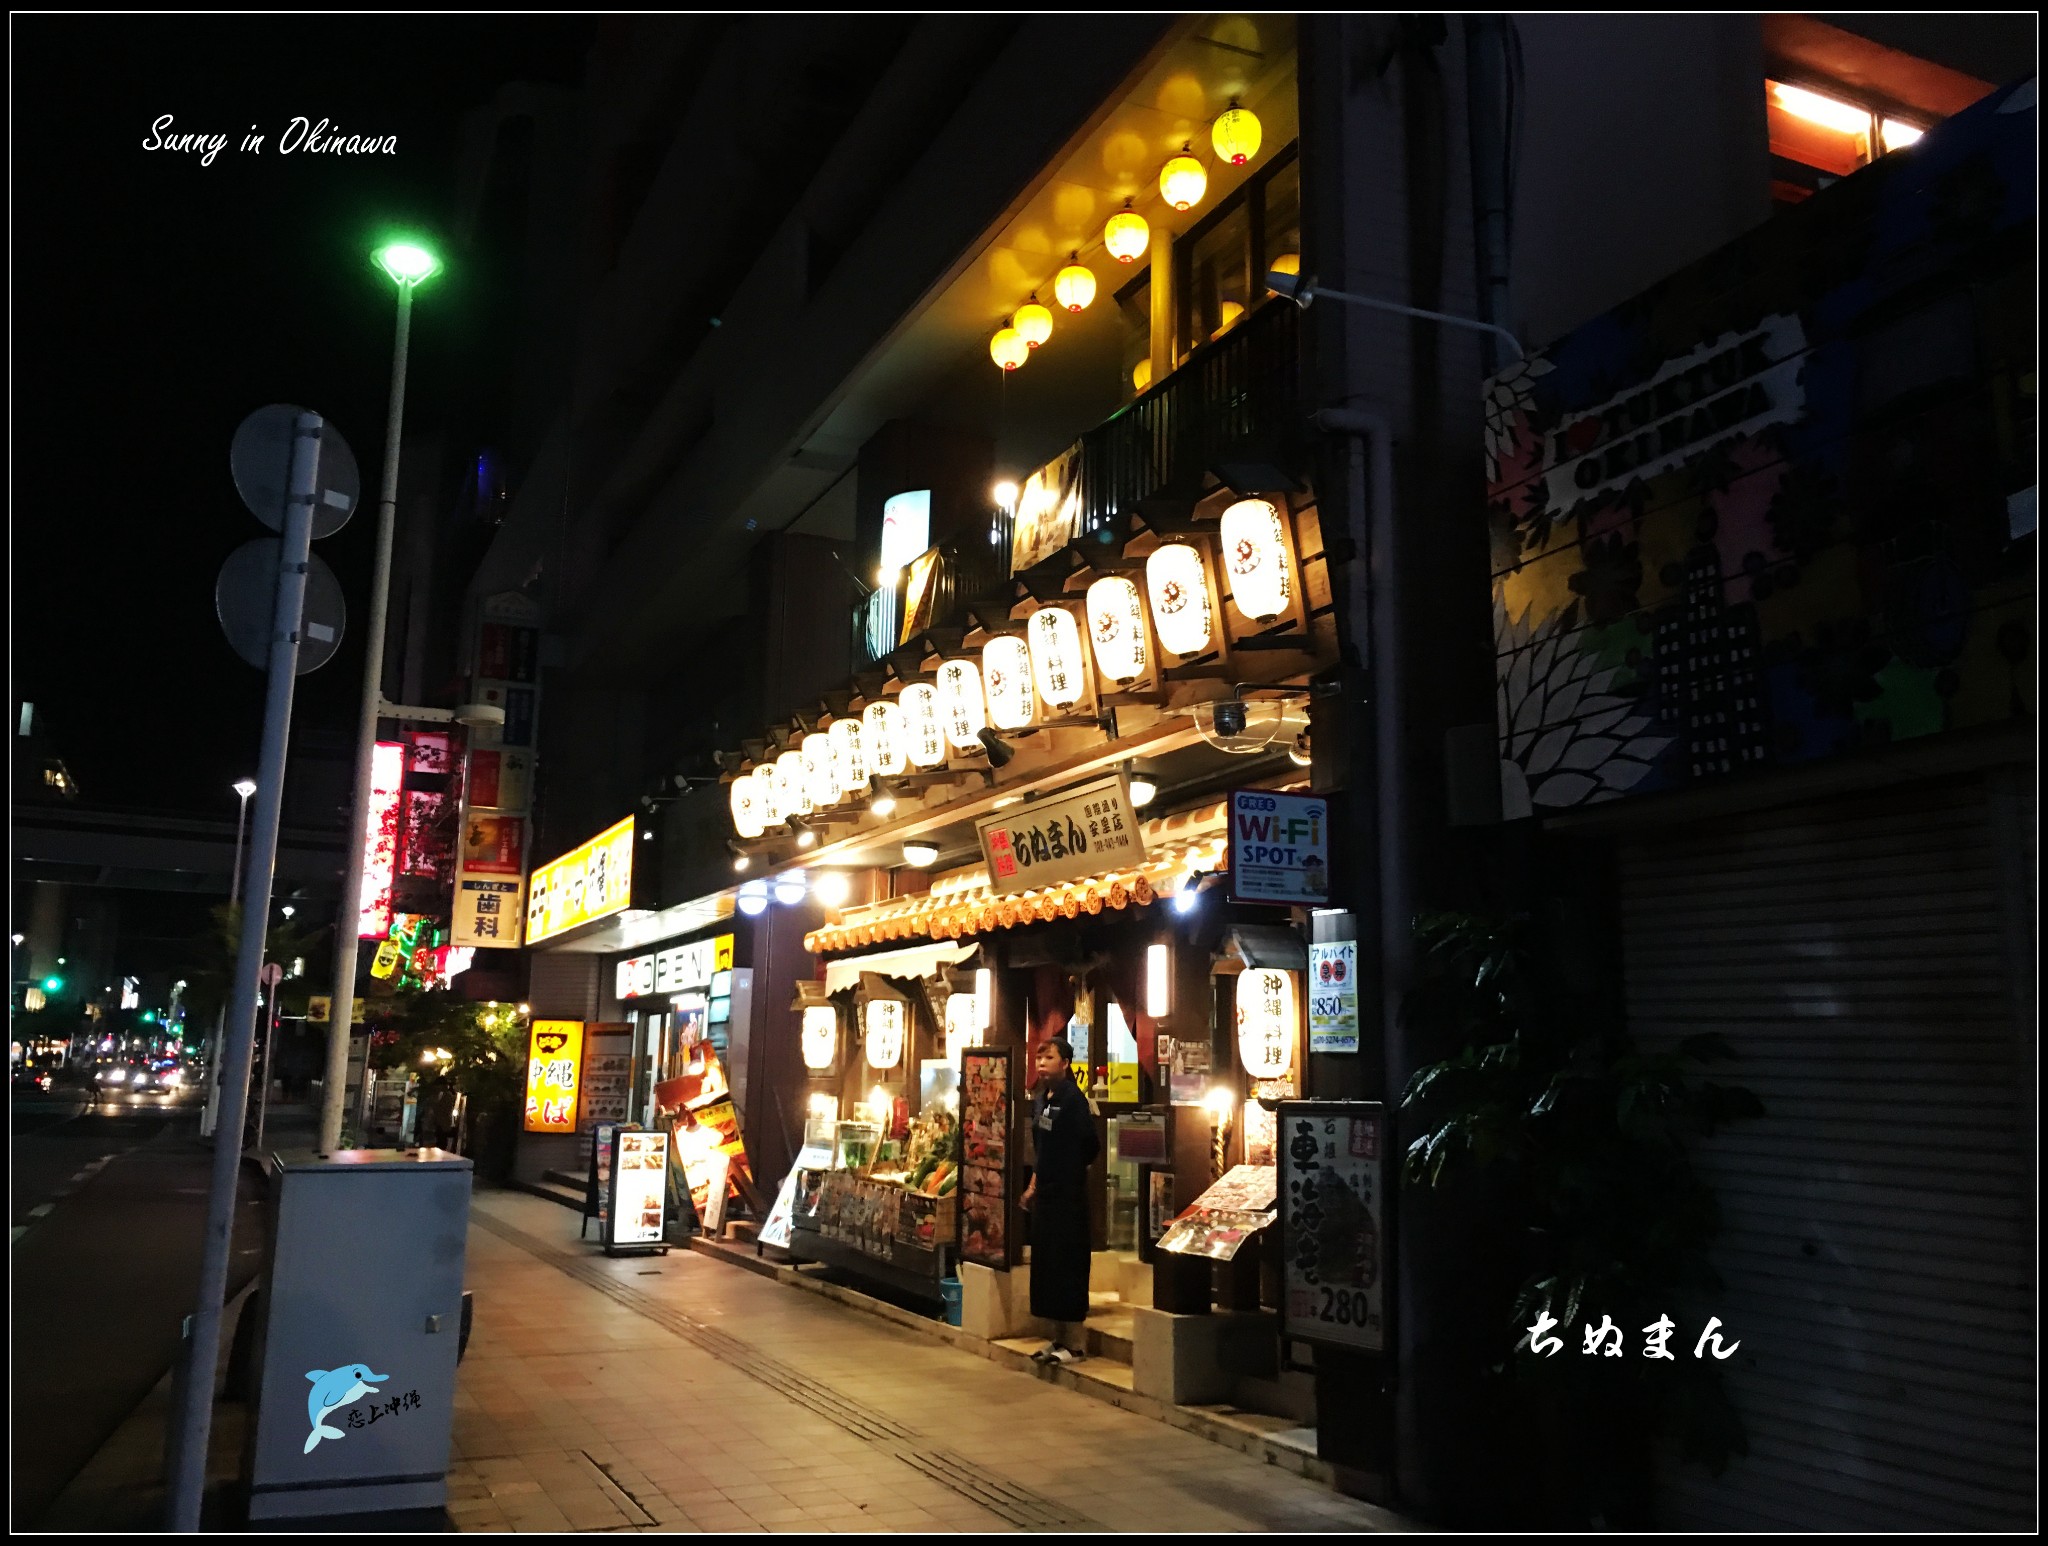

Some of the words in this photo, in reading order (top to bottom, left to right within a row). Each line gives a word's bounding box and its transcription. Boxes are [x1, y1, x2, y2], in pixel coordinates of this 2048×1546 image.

[1574, 381, 1774, 490] OKINAWA
[1039, 612, 1070, 693] 沖縄料理
[1240, 797, 1276, 811] FREE
[1011, 814, 1088, 867] ちぬまん
[1088, 813, 1124, 838] 安里店
[1238, 813, 1320, 847] Wi-Fi
[1243, 845, 1297, 866] SPOT
[474, 893, 502, 938] 歯科
[641, 949, 703, 989] OPEN
[1312, 945, 1355, 961] アルバイト
[1262, 973, 1284, 1066] 沖縄料理
[1316, 996, 1342, 1016] 850
